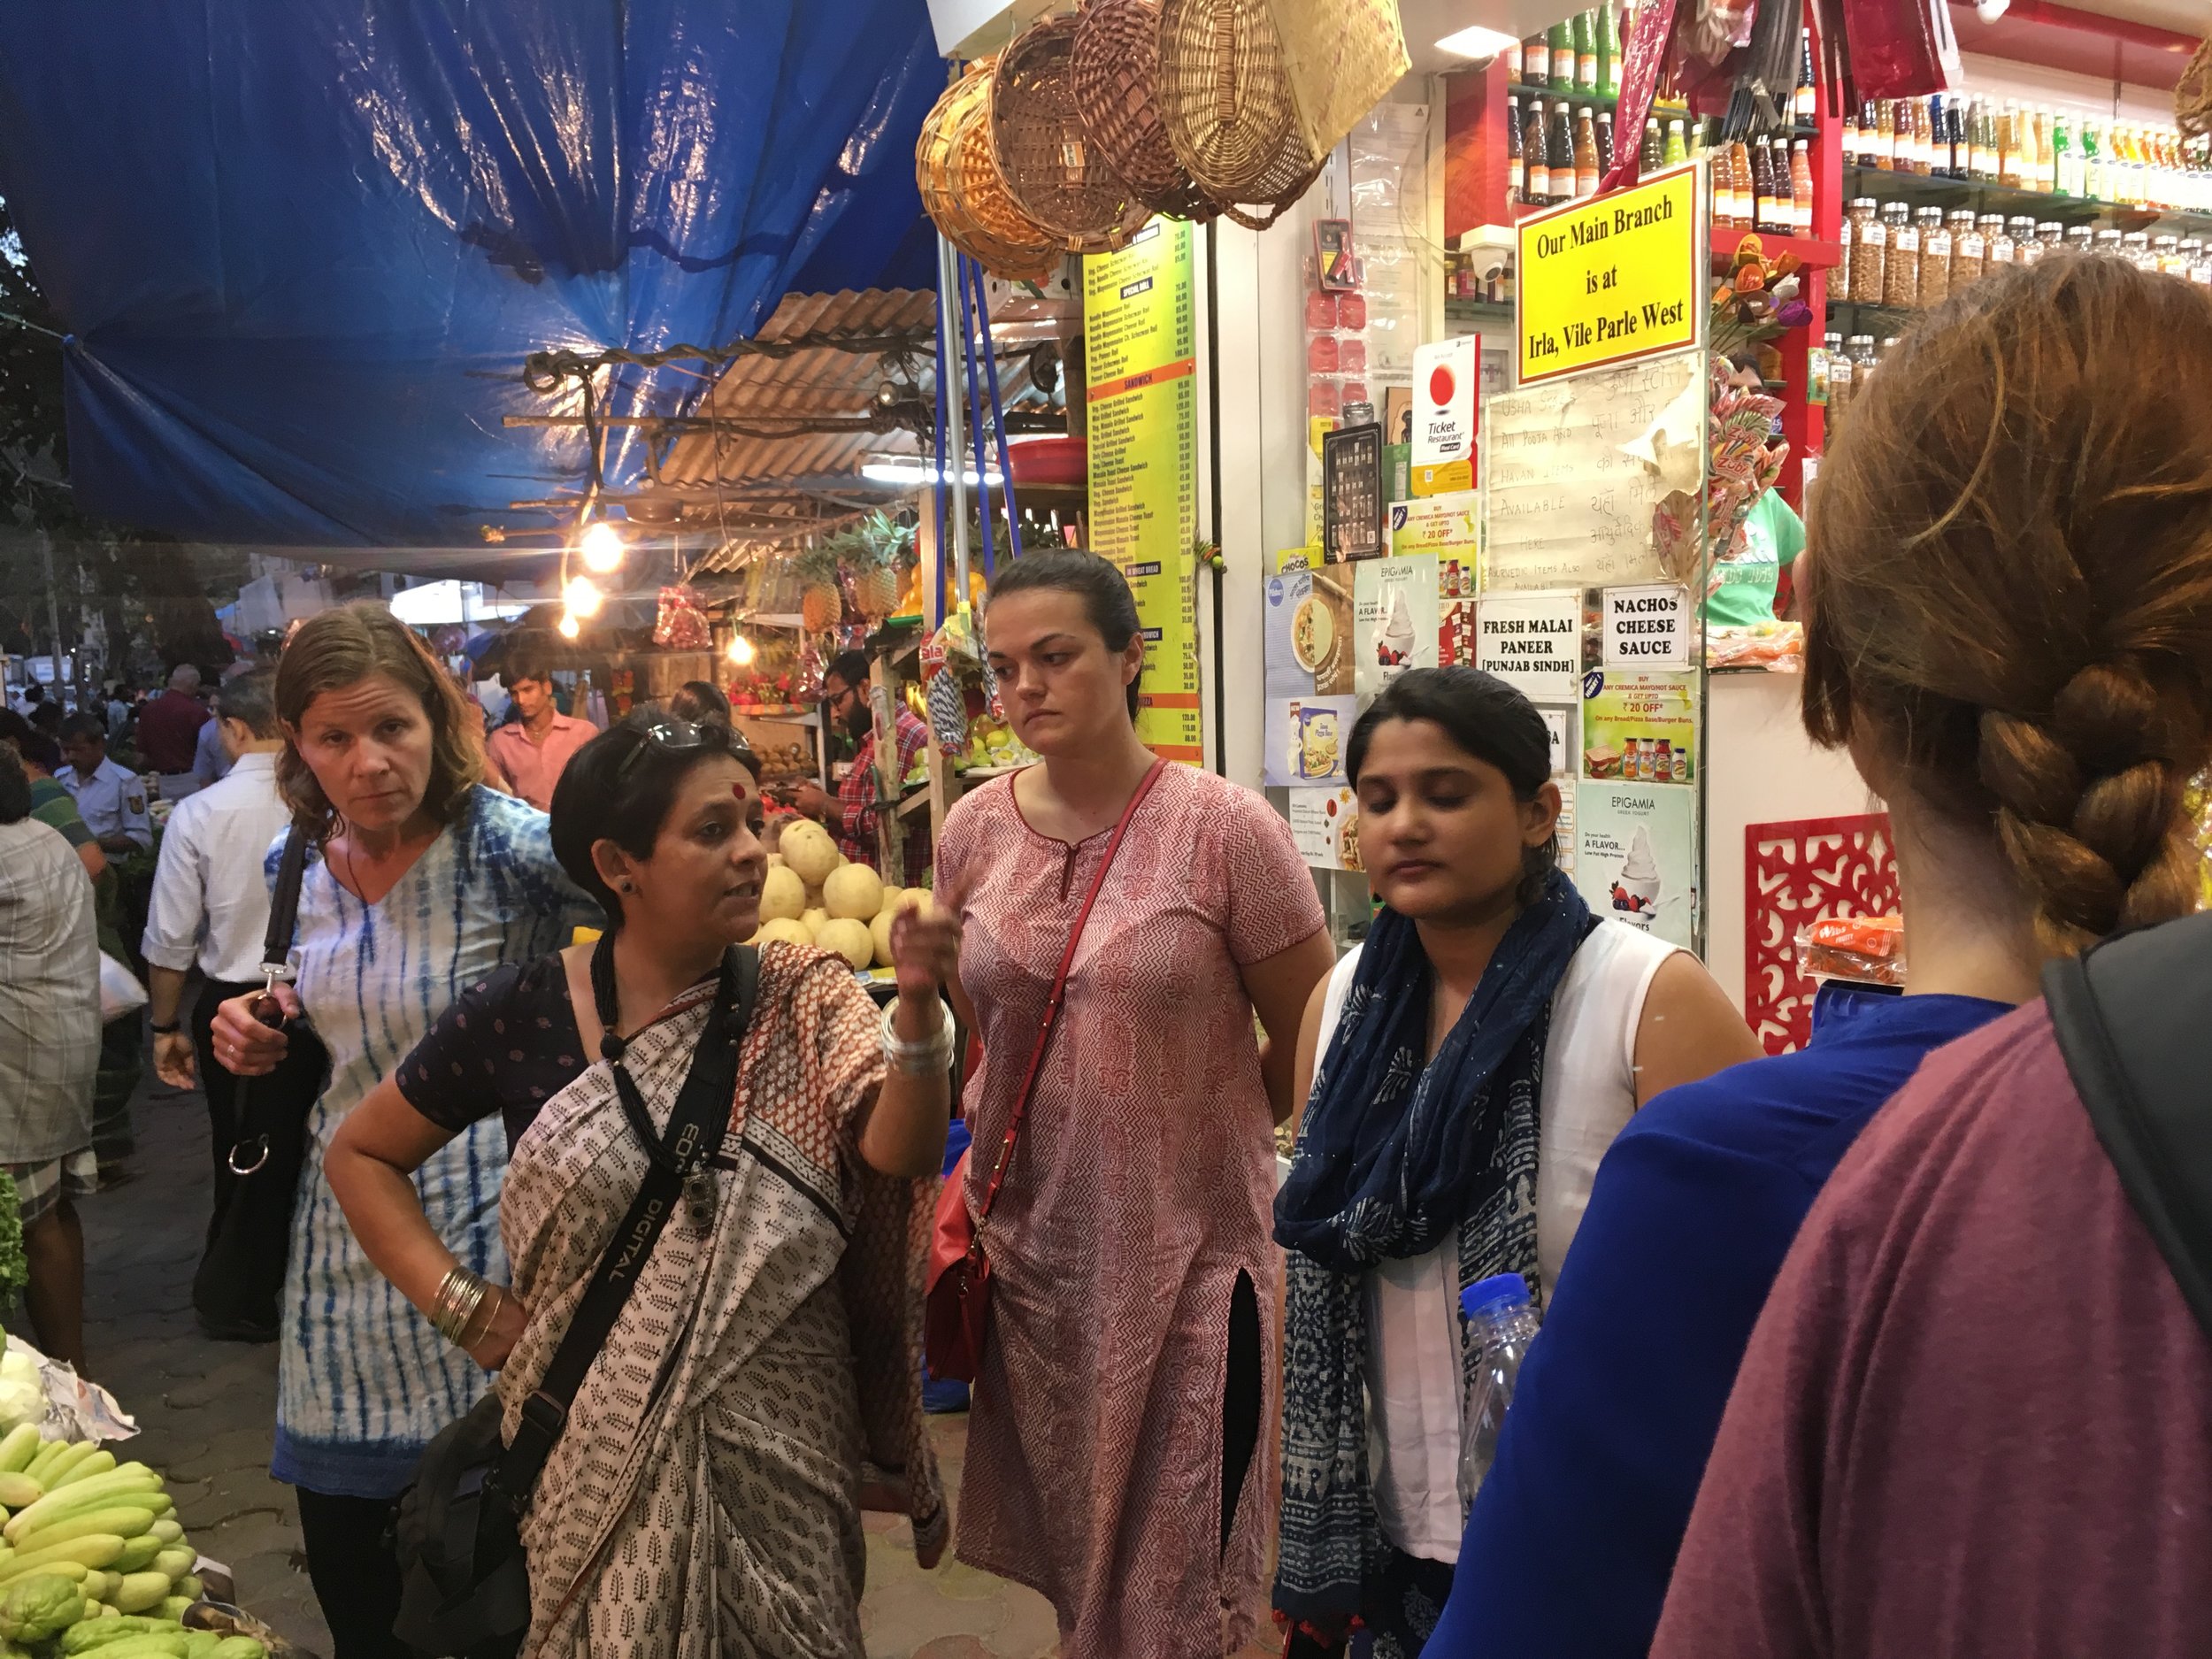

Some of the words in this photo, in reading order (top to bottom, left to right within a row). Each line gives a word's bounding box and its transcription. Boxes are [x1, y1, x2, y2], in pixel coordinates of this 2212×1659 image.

[1537, 233, 1566, 258] Our
[1570, 217, 1609, 249] Main
[1614, 195, 1672, 235] Branch
[1586, 270, 1598, 295] is
[1602, 265, 1617, 289] at
[1123, 284, 1139, 297] SPECIAL
[1139, 280, 1149, 291] ROLL
[1529, 332, 1559, 359] Irla,
[1563, 322, 1593, 349] Vile
[1596, 311, 1637, 342] Parle
[1642, 298, 1684, 330] West
[1125, 373, 1152, 389] SANDWICH
[1502, 397, 1531, 417] USHA
[1428, 421, 1455, 434] Ticket
[1501, 495, 1565, 516] AVAILABLE
[1521, 536, 1545, 550] HERE
[1145, 565, 1159, 573] BREAD
[1281, 557, 1309, 573] CHOCOS
[1614, 598, 1678, 613] NACHOS
[1483, 620, 1525, 634] FRESH
[1528, 619, 1573, 633] MALAI
[1616, 619, 1676, 634] CHEESE
[1501, 641, 1553, 654] PANEER
[1619, 641, 1671, 655] SAUCE
[1482, 659, 1530, 672] [PUNJAB
[1532, 659, 1574, 672] SINDH]
[1630, 703, 1640, 712] 20
[1611, 796, 1655, 810] EPIGAMIA
[609, 1198, 663, 1282] DIGITAL
